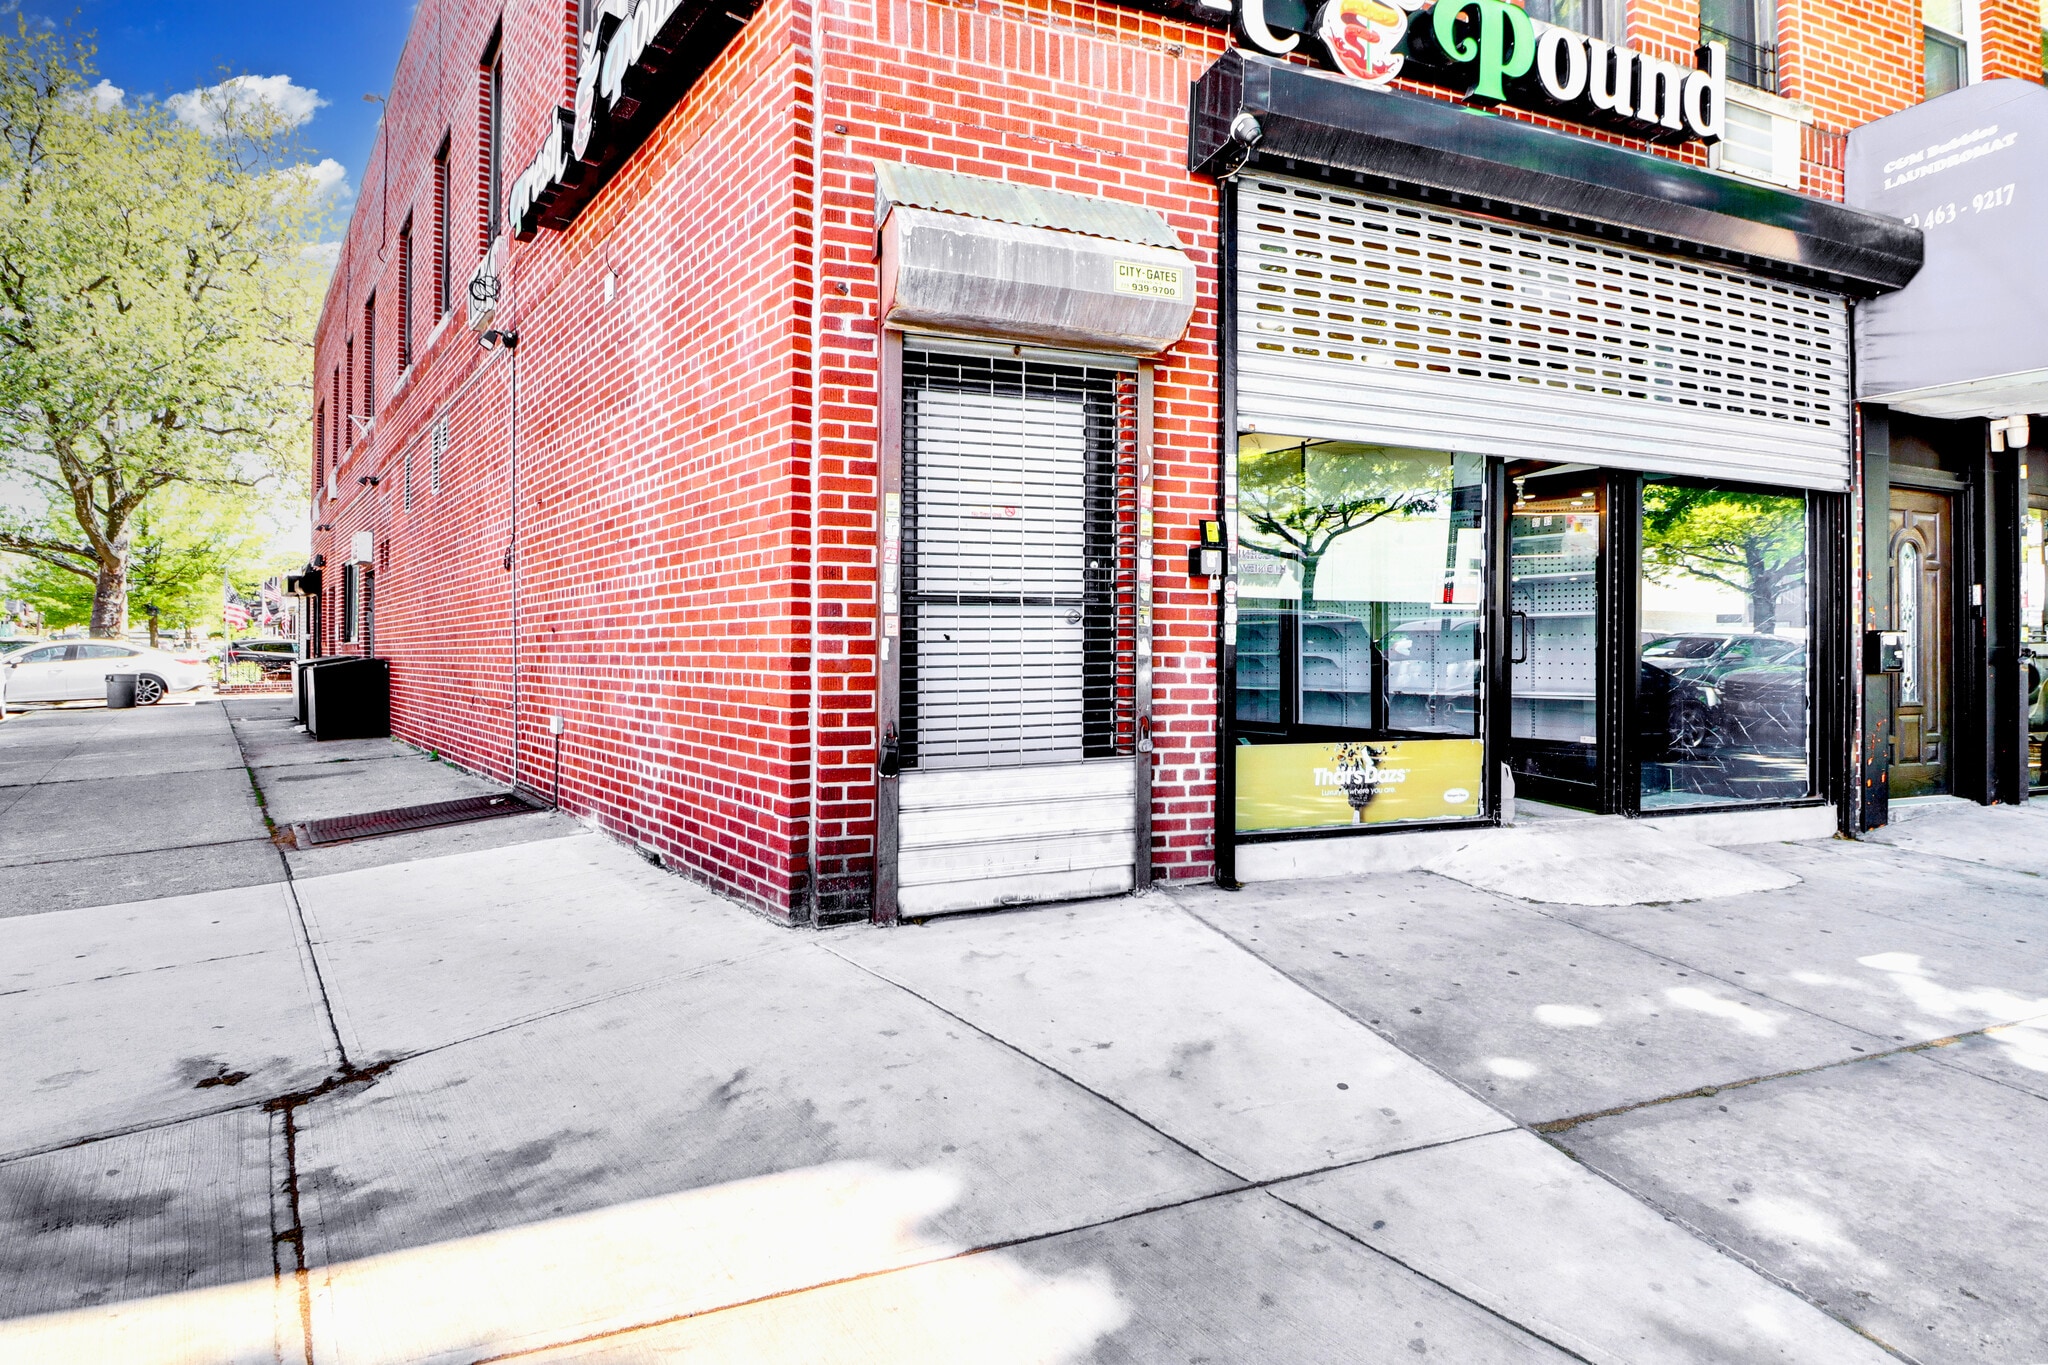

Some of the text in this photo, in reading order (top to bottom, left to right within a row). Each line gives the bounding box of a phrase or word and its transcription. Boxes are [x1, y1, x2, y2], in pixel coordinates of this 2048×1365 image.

[1432, 0, 1725, 141] Pound
[1884, 132, 2018, 190] LAUNDROMAT
[1923, 202, 1956, 230] 463
[1972, 183, 2015, 214] 9217
